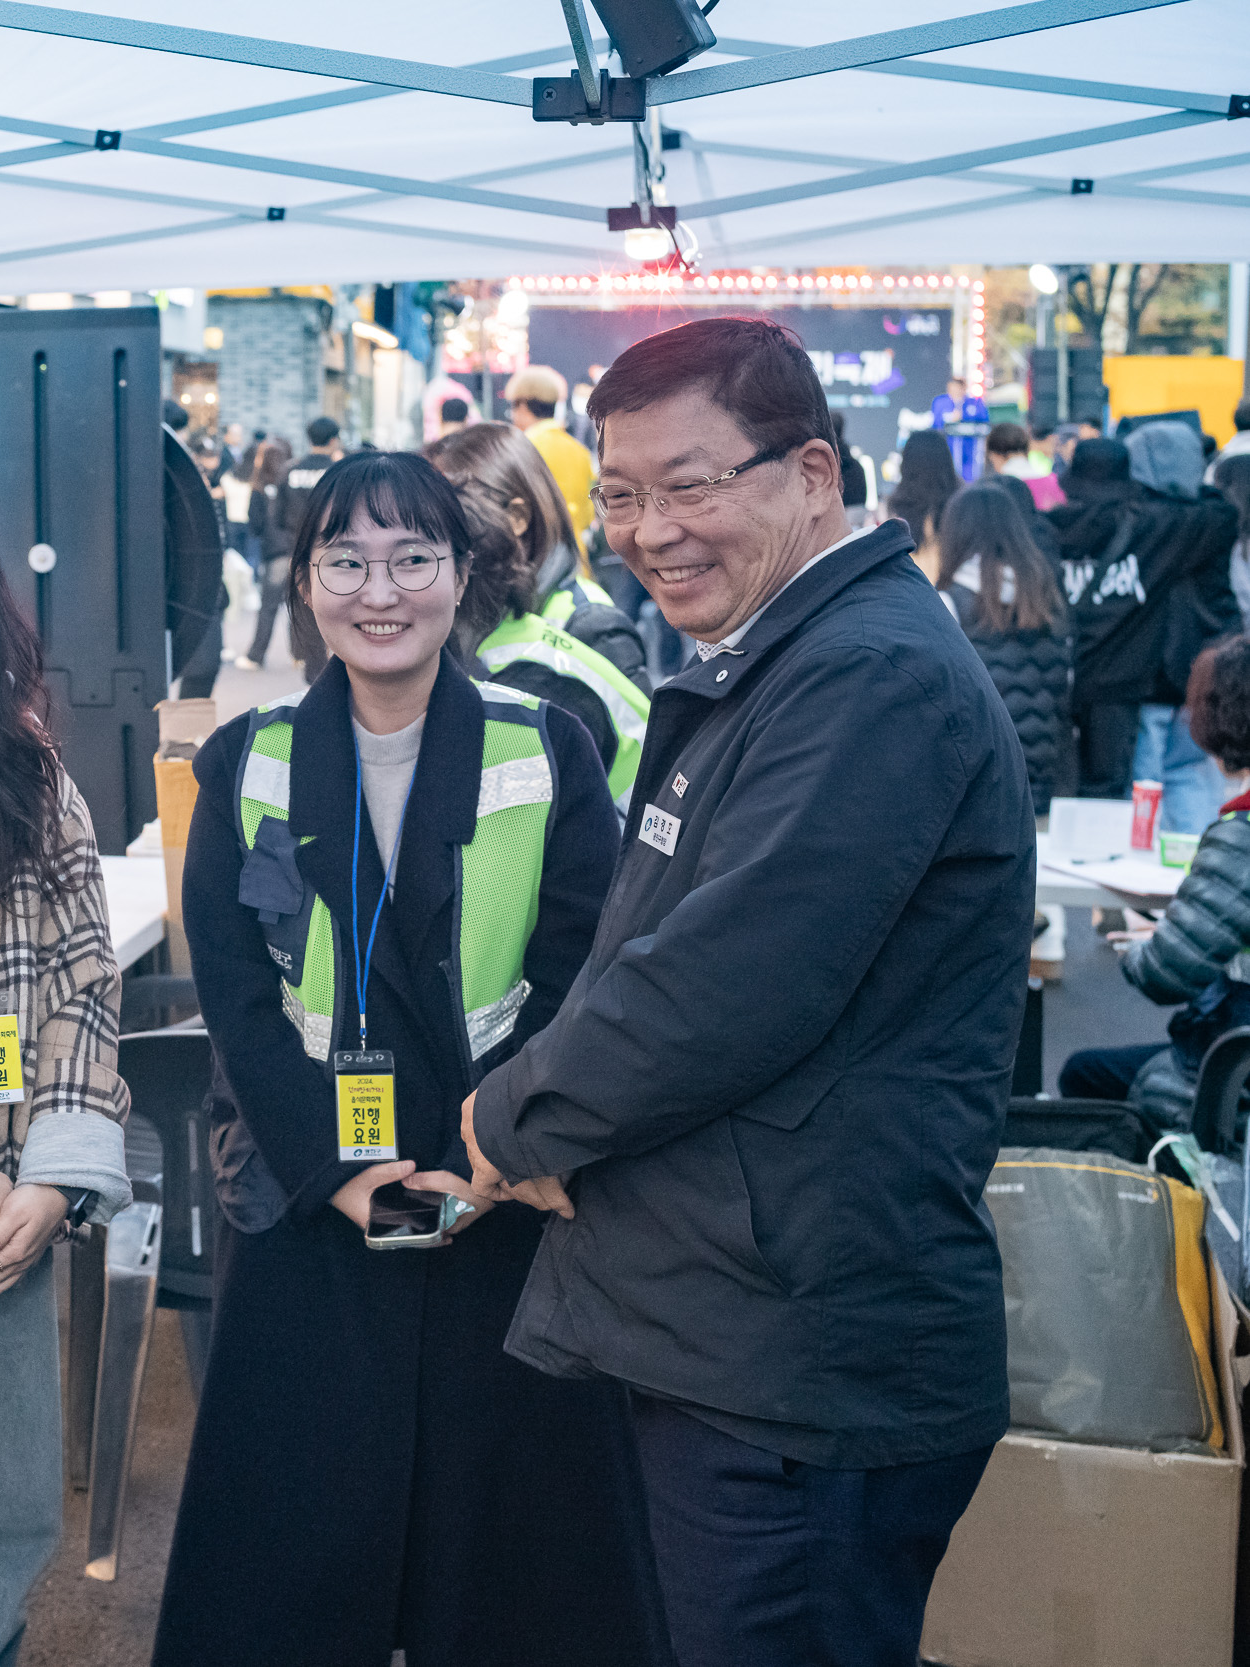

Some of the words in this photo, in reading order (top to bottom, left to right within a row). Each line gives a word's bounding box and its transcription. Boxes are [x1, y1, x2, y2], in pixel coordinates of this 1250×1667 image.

[266, 942, 293, 963] 진구
[352, 1107, 380, 1126] 진행
[353, 1128, 380, 1145] 요원
